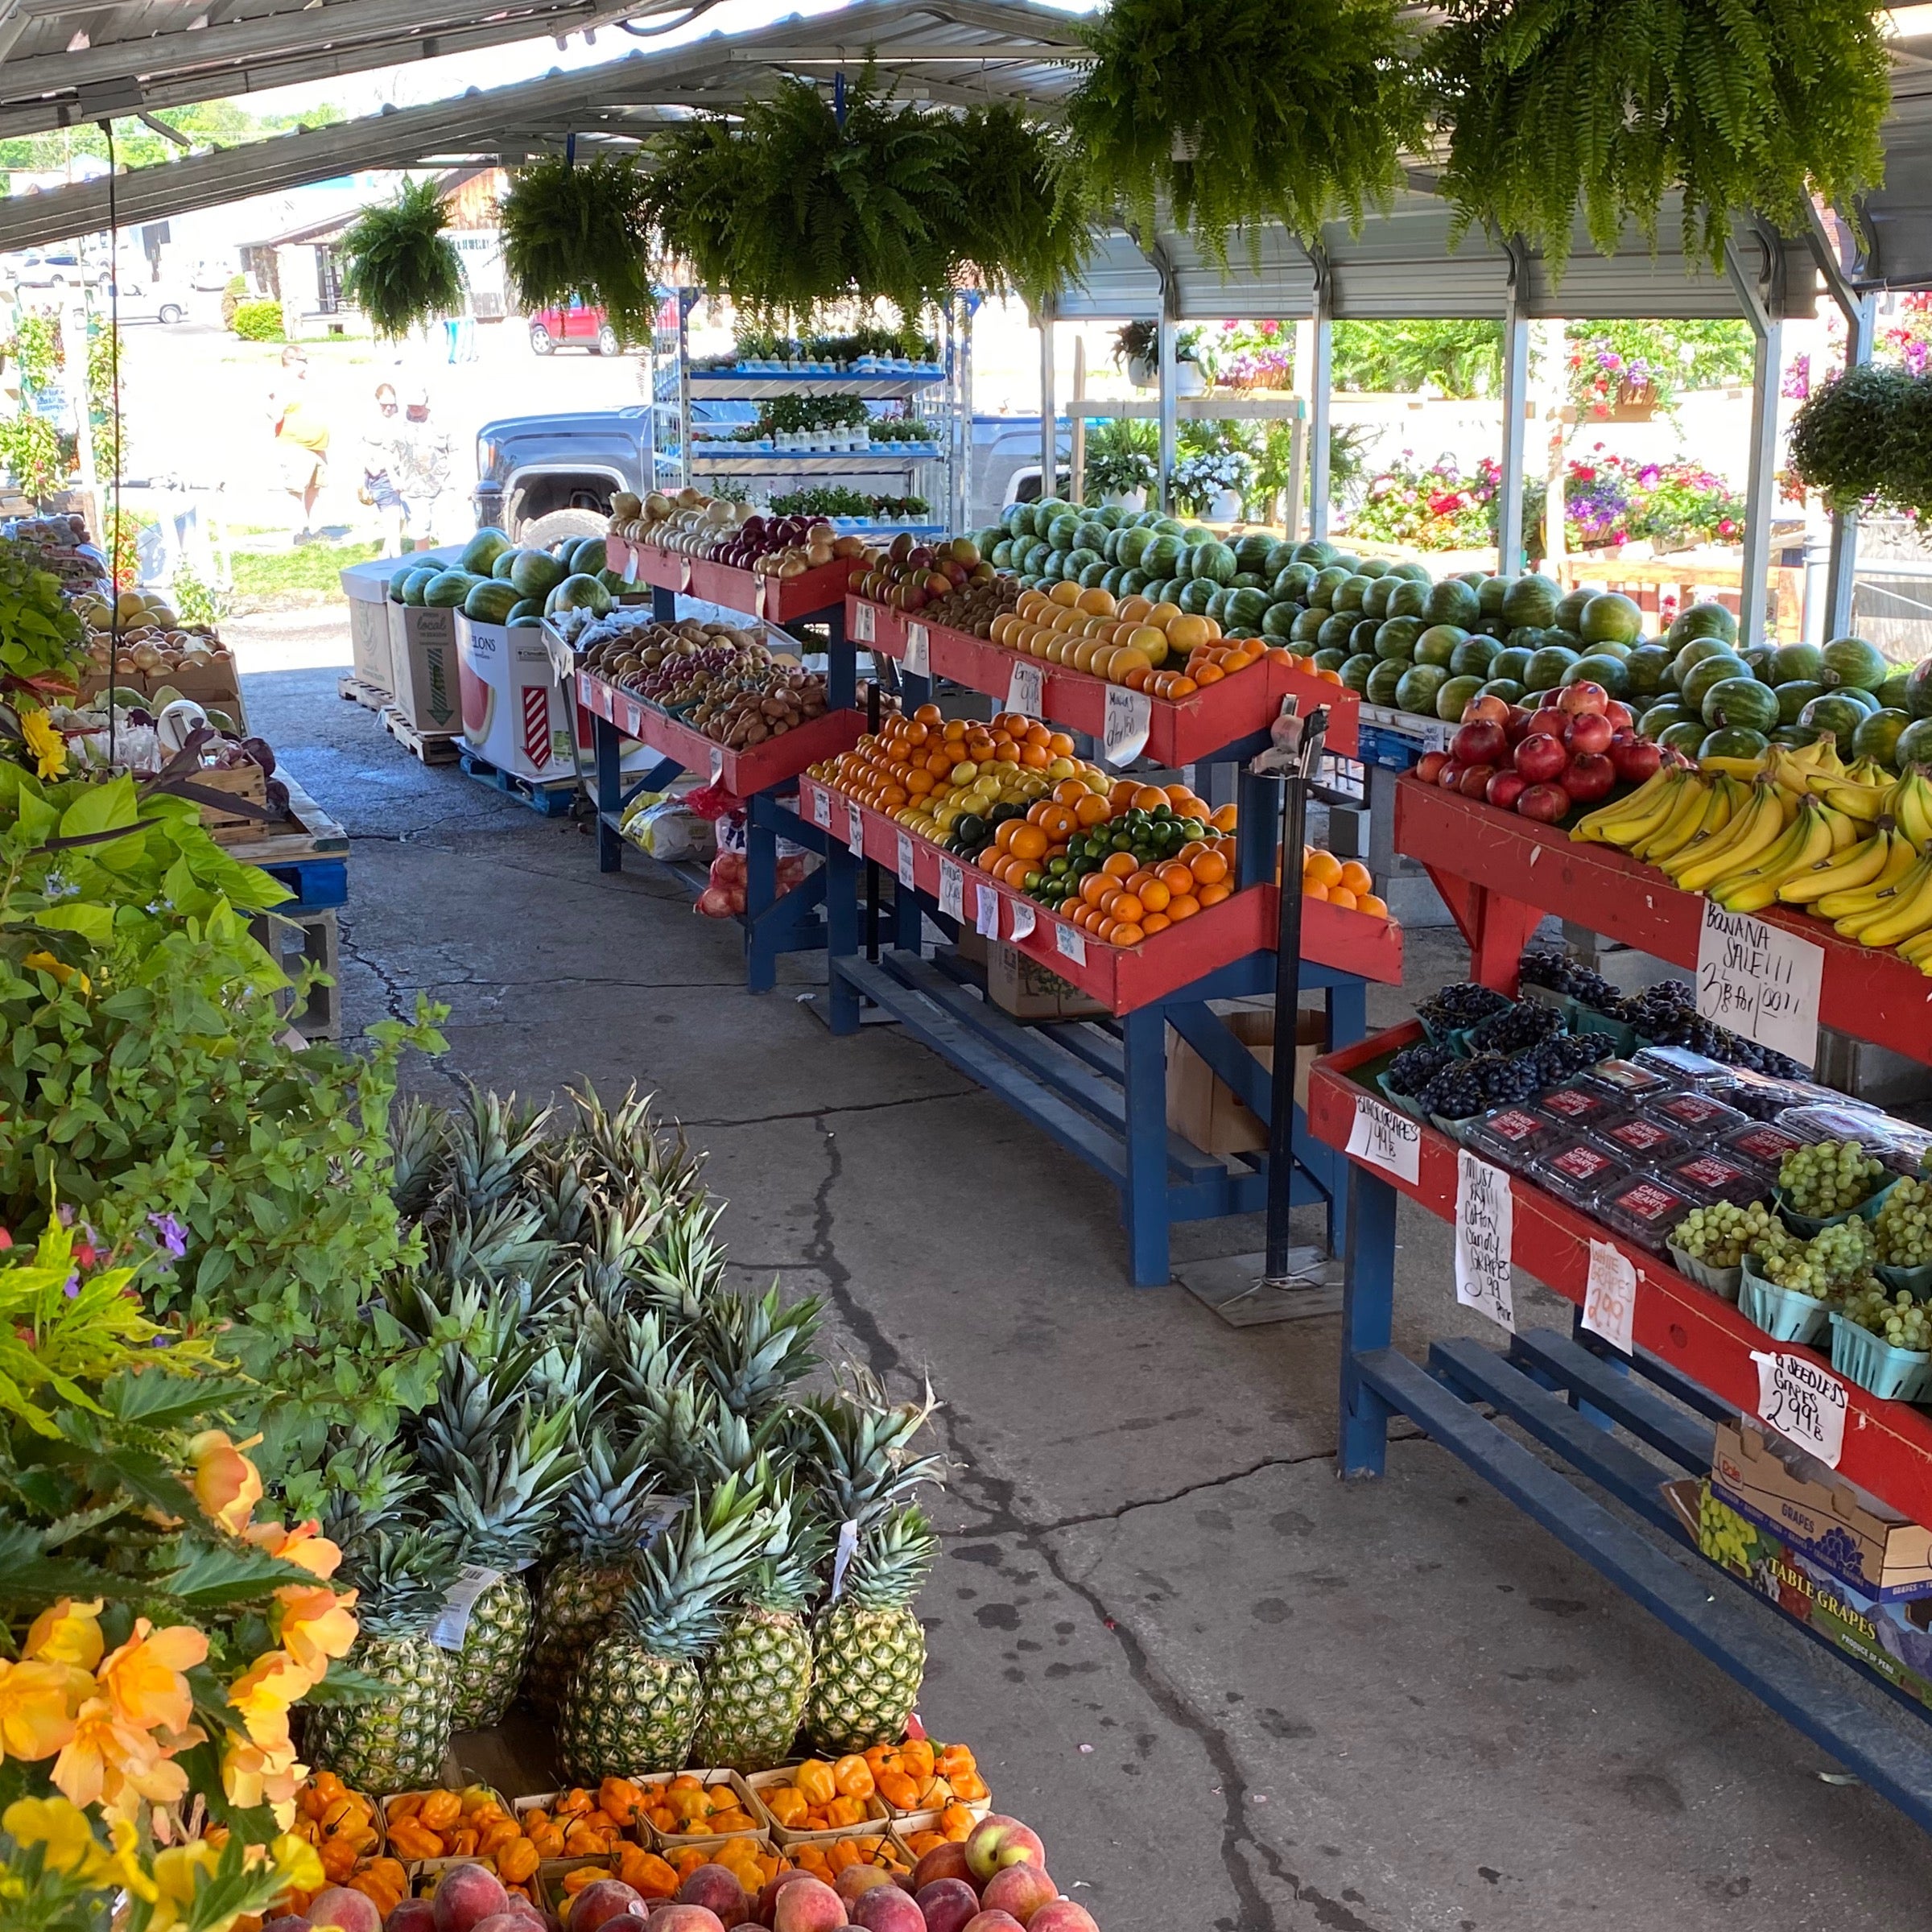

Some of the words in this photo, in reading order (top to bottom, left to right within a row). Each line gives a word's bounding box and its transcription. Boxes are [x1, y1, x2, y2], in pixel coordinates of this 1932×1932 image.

[1723, 936, 1794, 986] SALE!!!
[1703, 962, 1723, 1018] 3
[1555, 1093, 1588, 1110] HEARTS
[1564, 1090, 1594, 1104] CANDY
[1500, 1114, 1530, 1133] HEARTS
[1509, 1110, 1537, 1126] CANDY
[1624, 1125, 1657, 1142] HEARTS
[1633, 1121, 1663, 1137] CANDY
[1564, 1151, 1598, 1171] HEARTS
[1574, 1146, 1604, 1163] CANDY
[1690, 1162, 1728, 1181] HEARTS
[1699, 1158, 1733, 1174] CANDY
[1629, 1190, 1667, 1210] HEARTS
[1637, 1184, 1673, 1203] CANDY
[1723, 1460, 1740, 1480] Dole
[1781, 1503, 1814, 1534] GRAPES
[1770, 1557, 1814, 1600] TABLE
[1817, 1590, 1876, 1641] GRAPES
[1893, 1584, 1918, 1596] GRAPES
[1841, 1633, 1868, 1657] PRODUCE
[1869, 1653, 1878, 1662] OF
